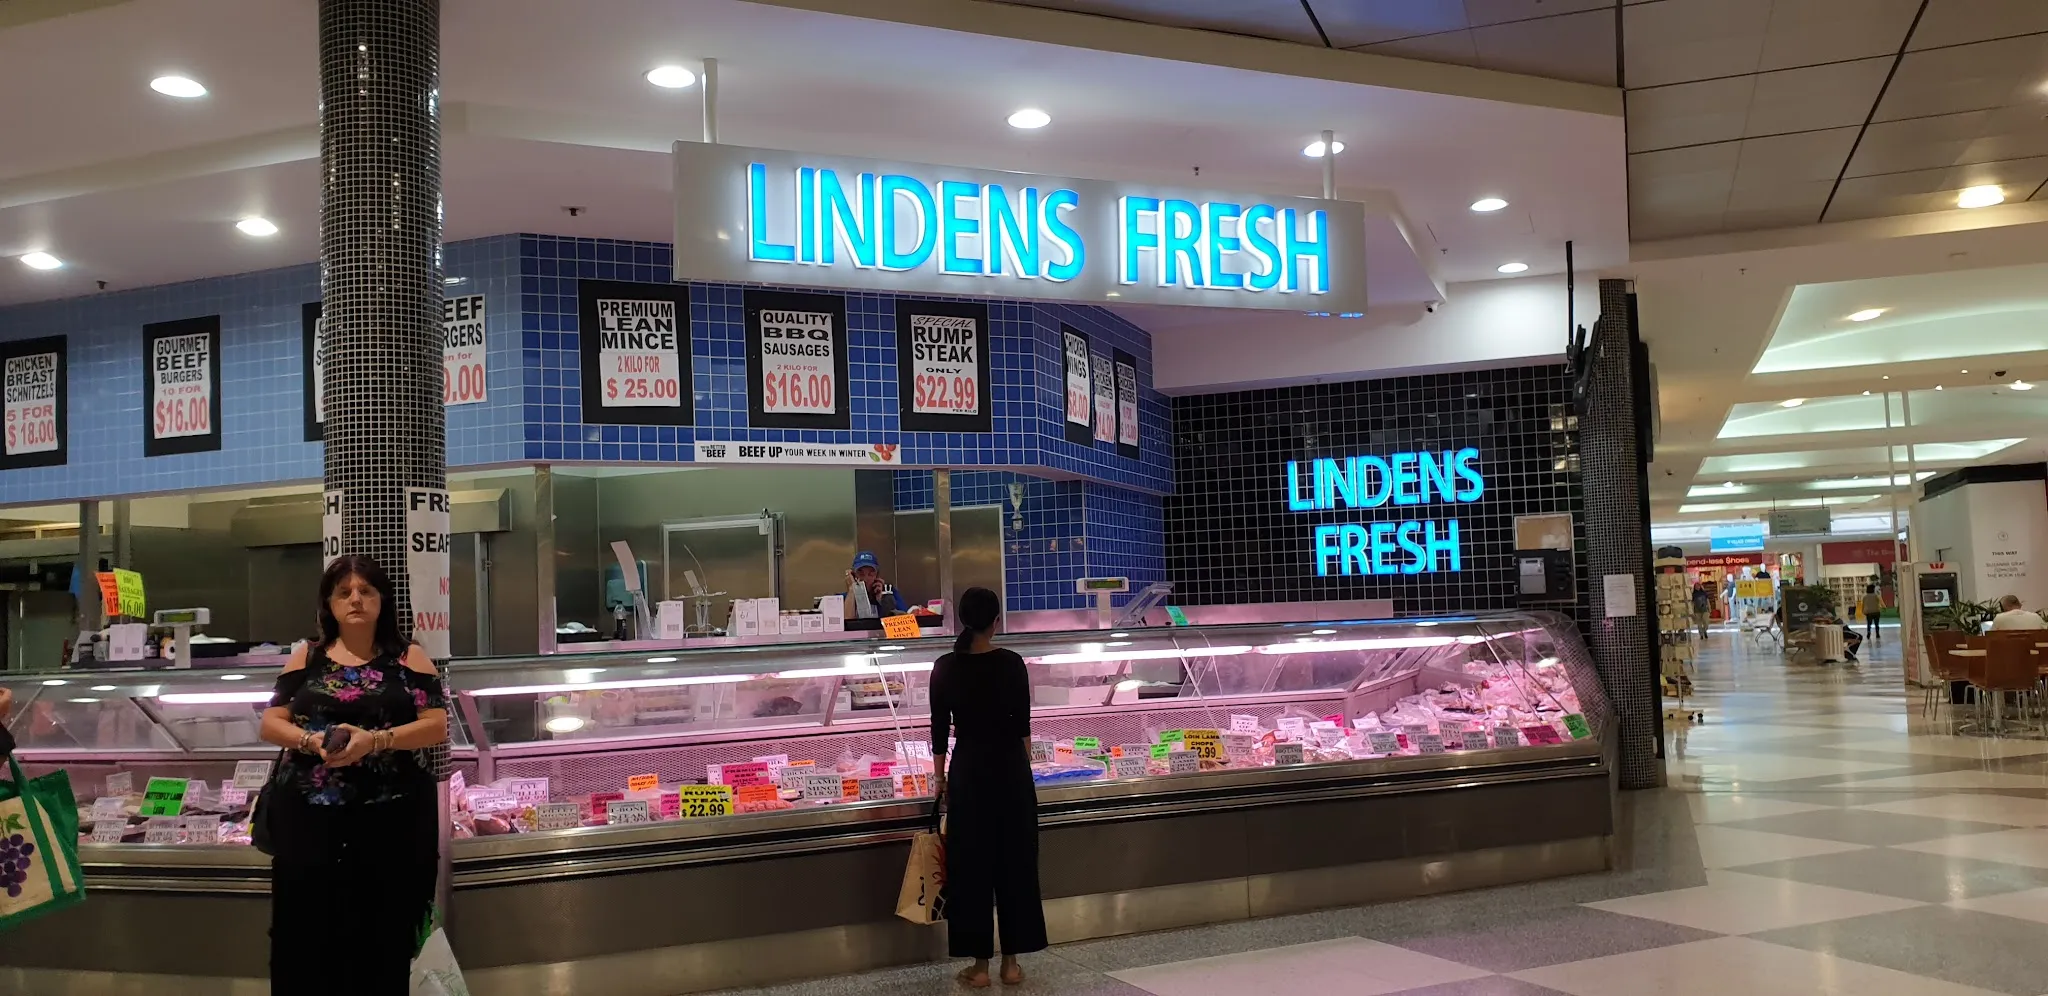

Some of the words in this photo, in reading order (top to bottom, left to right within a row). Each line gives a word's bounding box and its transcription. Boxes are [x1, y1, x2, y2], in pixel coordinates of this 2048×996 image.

[747, 162, 1086, 283] LINDENS
[1118, 194, 1330, 296] FRESH
[443, 296, 483, 323] EEF
[600, 302, 673, 318] PREMIUM
[600, 317, 673, 332] LEAN
[763, 312, 829, 326] QUALITY
[913, 316, 973, 328] SPECIAL
[601, 332, 674, 350] MINCE
[763, 327, 830, 341] BBQ
[913, 326, 974, 345] RUMP
[157, 336, 207, 355] GOURMET
[763, 342, 830, 357] SAUSAGES
[914, 343, 974, 363] STEAK
[1065, 333, 1087, 359] CHICKEN
[8, 355, 52, 373] CHICKEN
[156, 352, 207, 371] BEEF
[458, 352, 472, 360] for
[618, 356, 622, 372] 2
[624, 356, 643, 373] KILO
[645, 356, 660, 373] FOR
[1067, 354, 1087, 378] WINGS
[7, 369, 54, 387] BREAST
[161, 369, 202, 384] BURGERS
[7, 382, 54, 402] SCHNITZELS
[162, 387, 175, 396] 10
[178, 385, 201, 394] FOR
[624, 378, 677, 398] 25.00
[765, 371, 832, 411] $16.00
[915, 373, 975, 411] $22.99
[7, 410, 16, 421] 5
[22, 405, 53, 420] FOR
[1068, 389, 1088, 420] $8.00
[156, 396, 208, 434] $16.00
[21, 419, 55, 445] 18.00
[707, 449, 726, 458] BEEF
[739, 445, 766, 458] BEEF
[769, 446, 783, 458] UP
[785, 448, 804, 457] YOUR
[806, 449, 827, 457] WEEK
[829, 449, 837, 457] IN
[839, 450, 867, 458] WINTER
[1287, 447, 1484, 512] LINDENS
[410, 492, 449, 512] FRE
[1314, 519, 1462, 577] FRESH
[1686, 558, 1724, 566] pend-less
[885, 619, 916, 627] PREMIUM
[782, 768, 814, 776] CHICKEN
[145, 792, 168, 800] BUTTERFLY
[690, 804, 725, 816] 22.99
